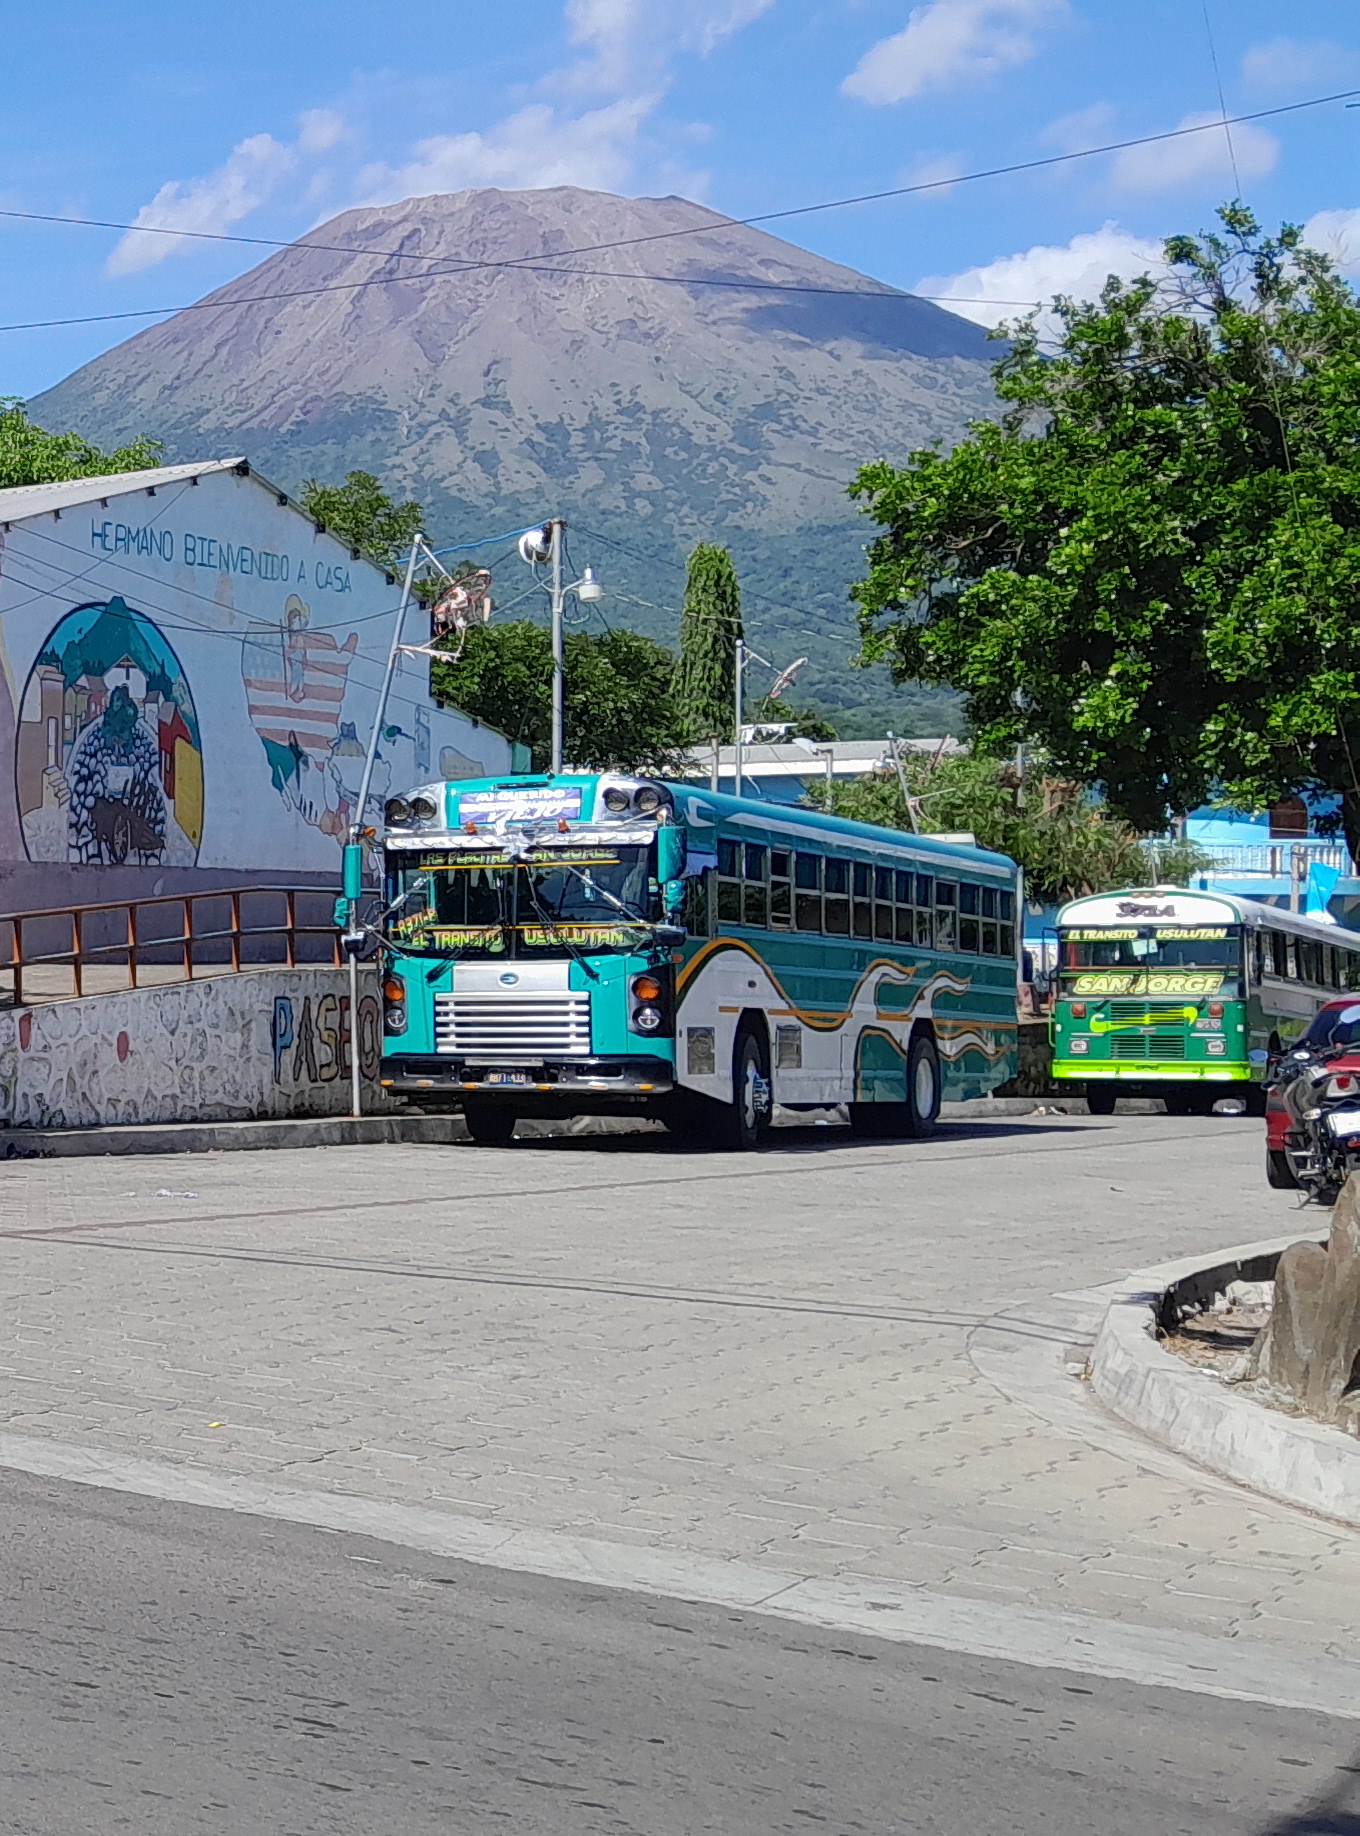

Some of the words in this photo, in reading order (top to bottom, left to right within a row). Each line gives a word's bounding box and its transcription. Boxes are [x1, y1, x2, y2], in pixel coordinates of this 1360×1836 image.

[91, 519, 173, 562] HERMANO
[184, 533, 289, 582] BIENVENIDO
[297, 560, 306, 585] A
[315, 561, 352, 593] CASA
[1083, 929, 1138, 940] TRANSITO
[1156, 928, 1227, 939] USULUTAN
[1074, 975, 1132, 995] SAN
[1134, 974, 1225, 995] JORGE
[271, 993, 381, 1085] PASEO
